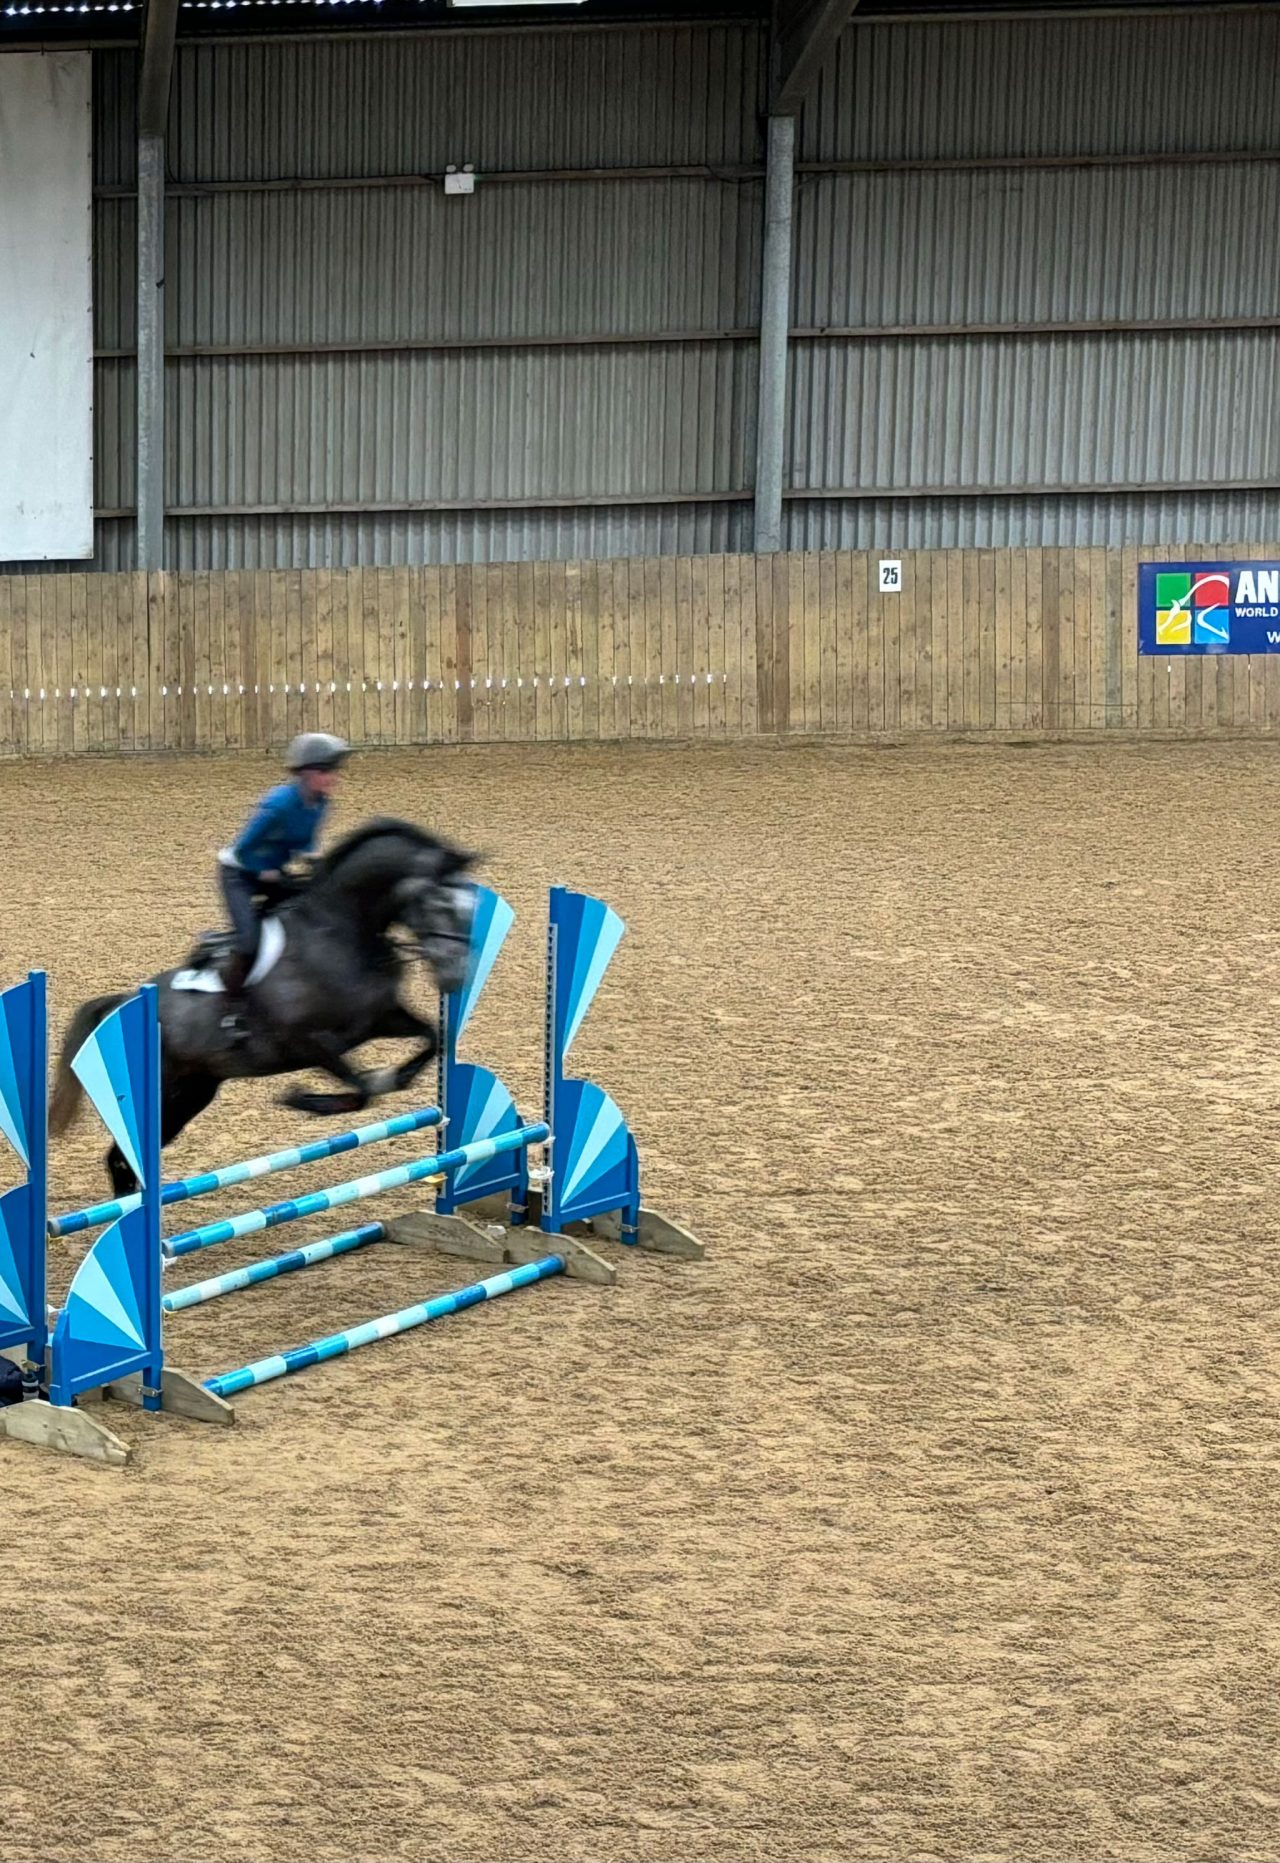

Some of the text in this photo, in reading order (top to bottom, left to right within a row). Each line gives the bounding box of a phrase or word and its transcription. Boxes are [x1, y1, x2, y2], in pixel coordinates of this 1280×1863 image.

[883, 567, 898, 585] 25
[1235, 570, 1279, 604] AN
[1235, 606, 1279, 618] WORLD
